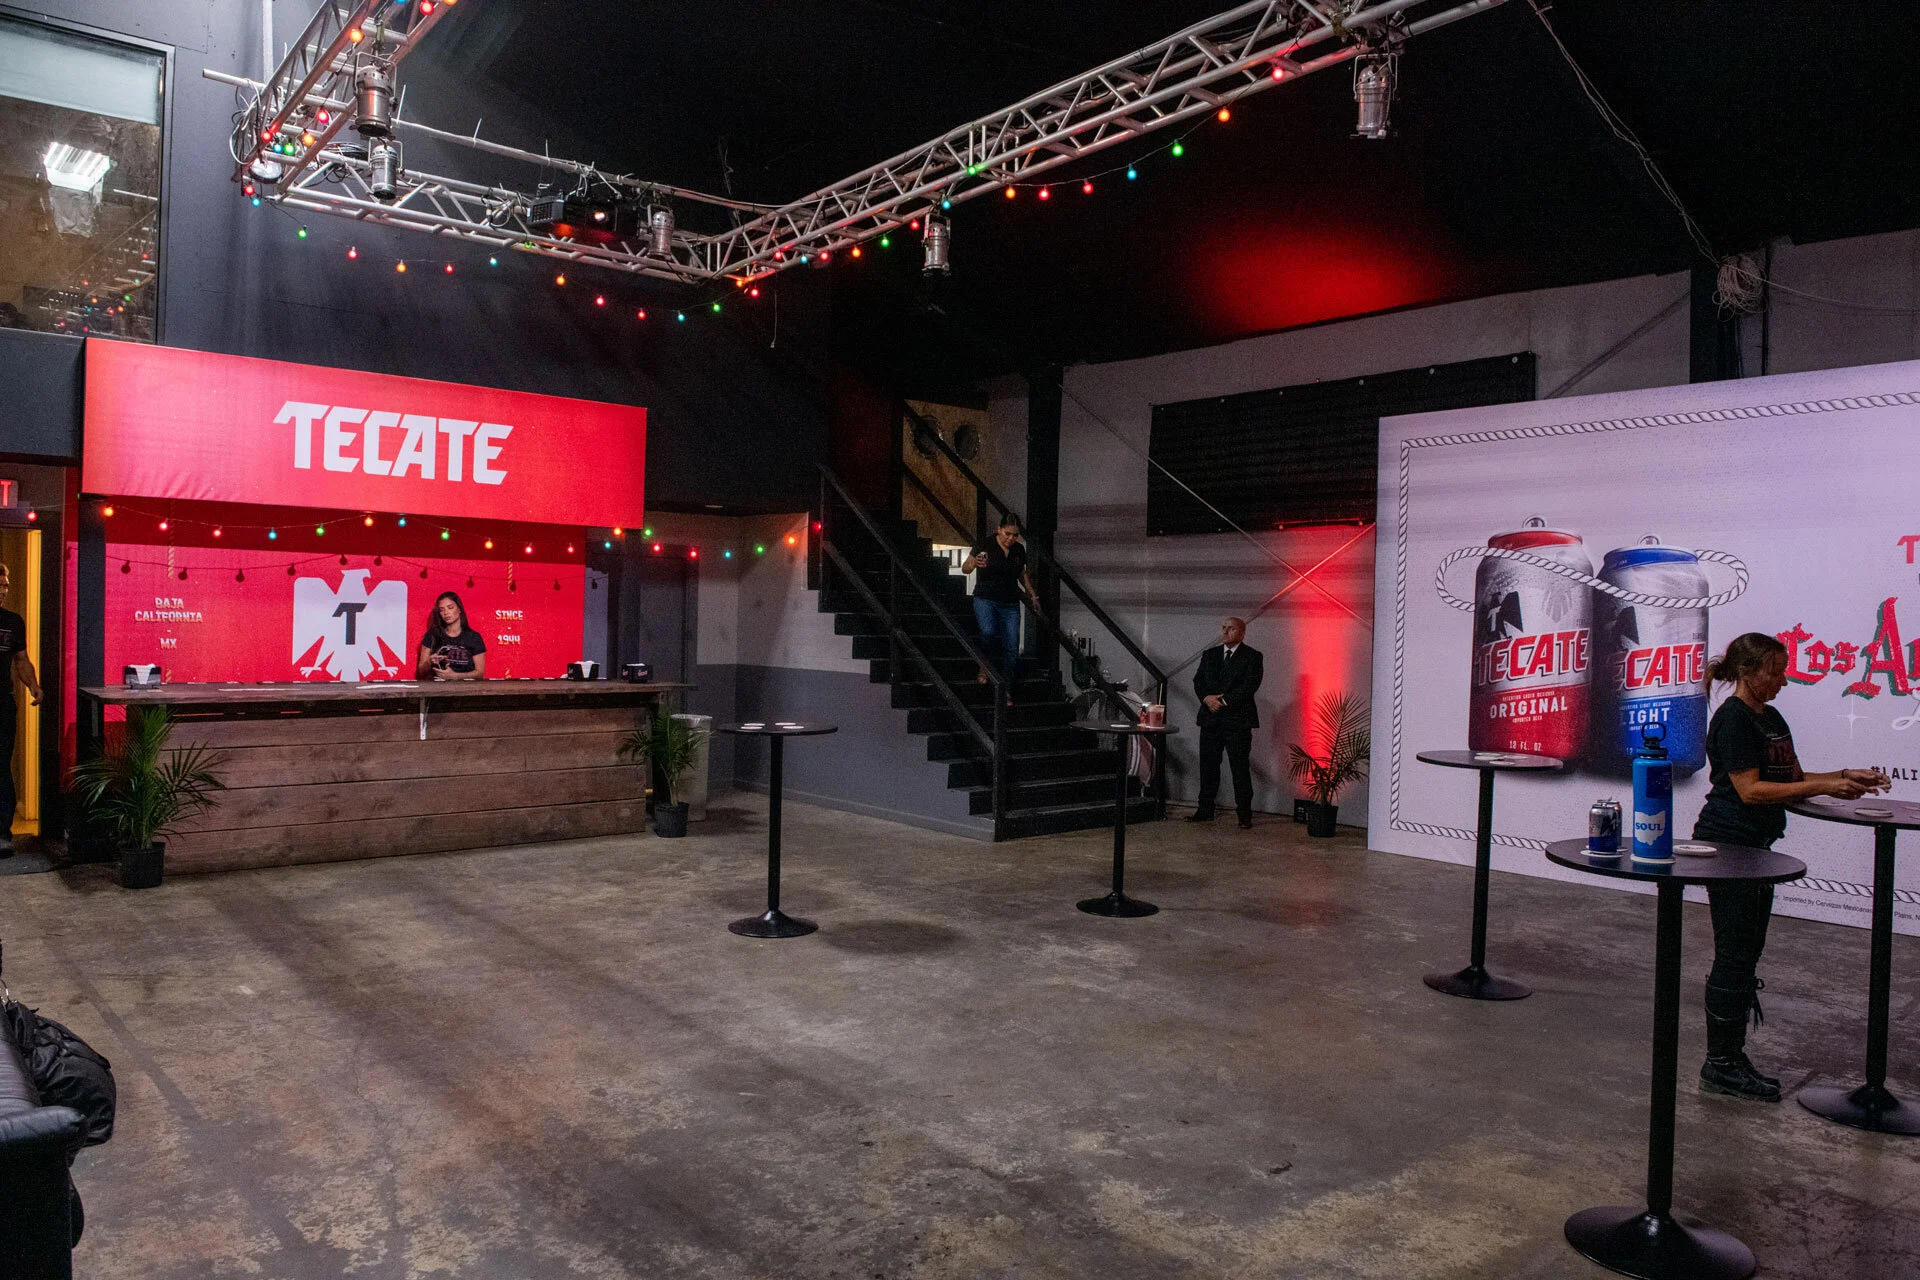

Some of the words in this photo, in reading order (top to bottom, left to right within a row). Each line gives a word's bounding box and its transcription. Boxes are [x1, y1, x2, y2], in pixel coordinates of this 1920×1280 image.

[273, 400, 514, 485] TECATE
[155, 597, 184, 609] BAJA
[135, 611, 203, 623] CALIFORNIA
[495, 609, 523, 620] SINCE
[332, 602, 368, 645] T
[160, 638, 177, 649] MX
[497, 635, 520, 645] 1944
[1476, 628, 1590, 686] TECATE
[1490, 696, 1567, 718] ORIGINAL
[1621, 707, 1670, 725] IGHT
[1635, 822, 1663, 831] SOUL
[1783, 896, 1807, 904] Imported
